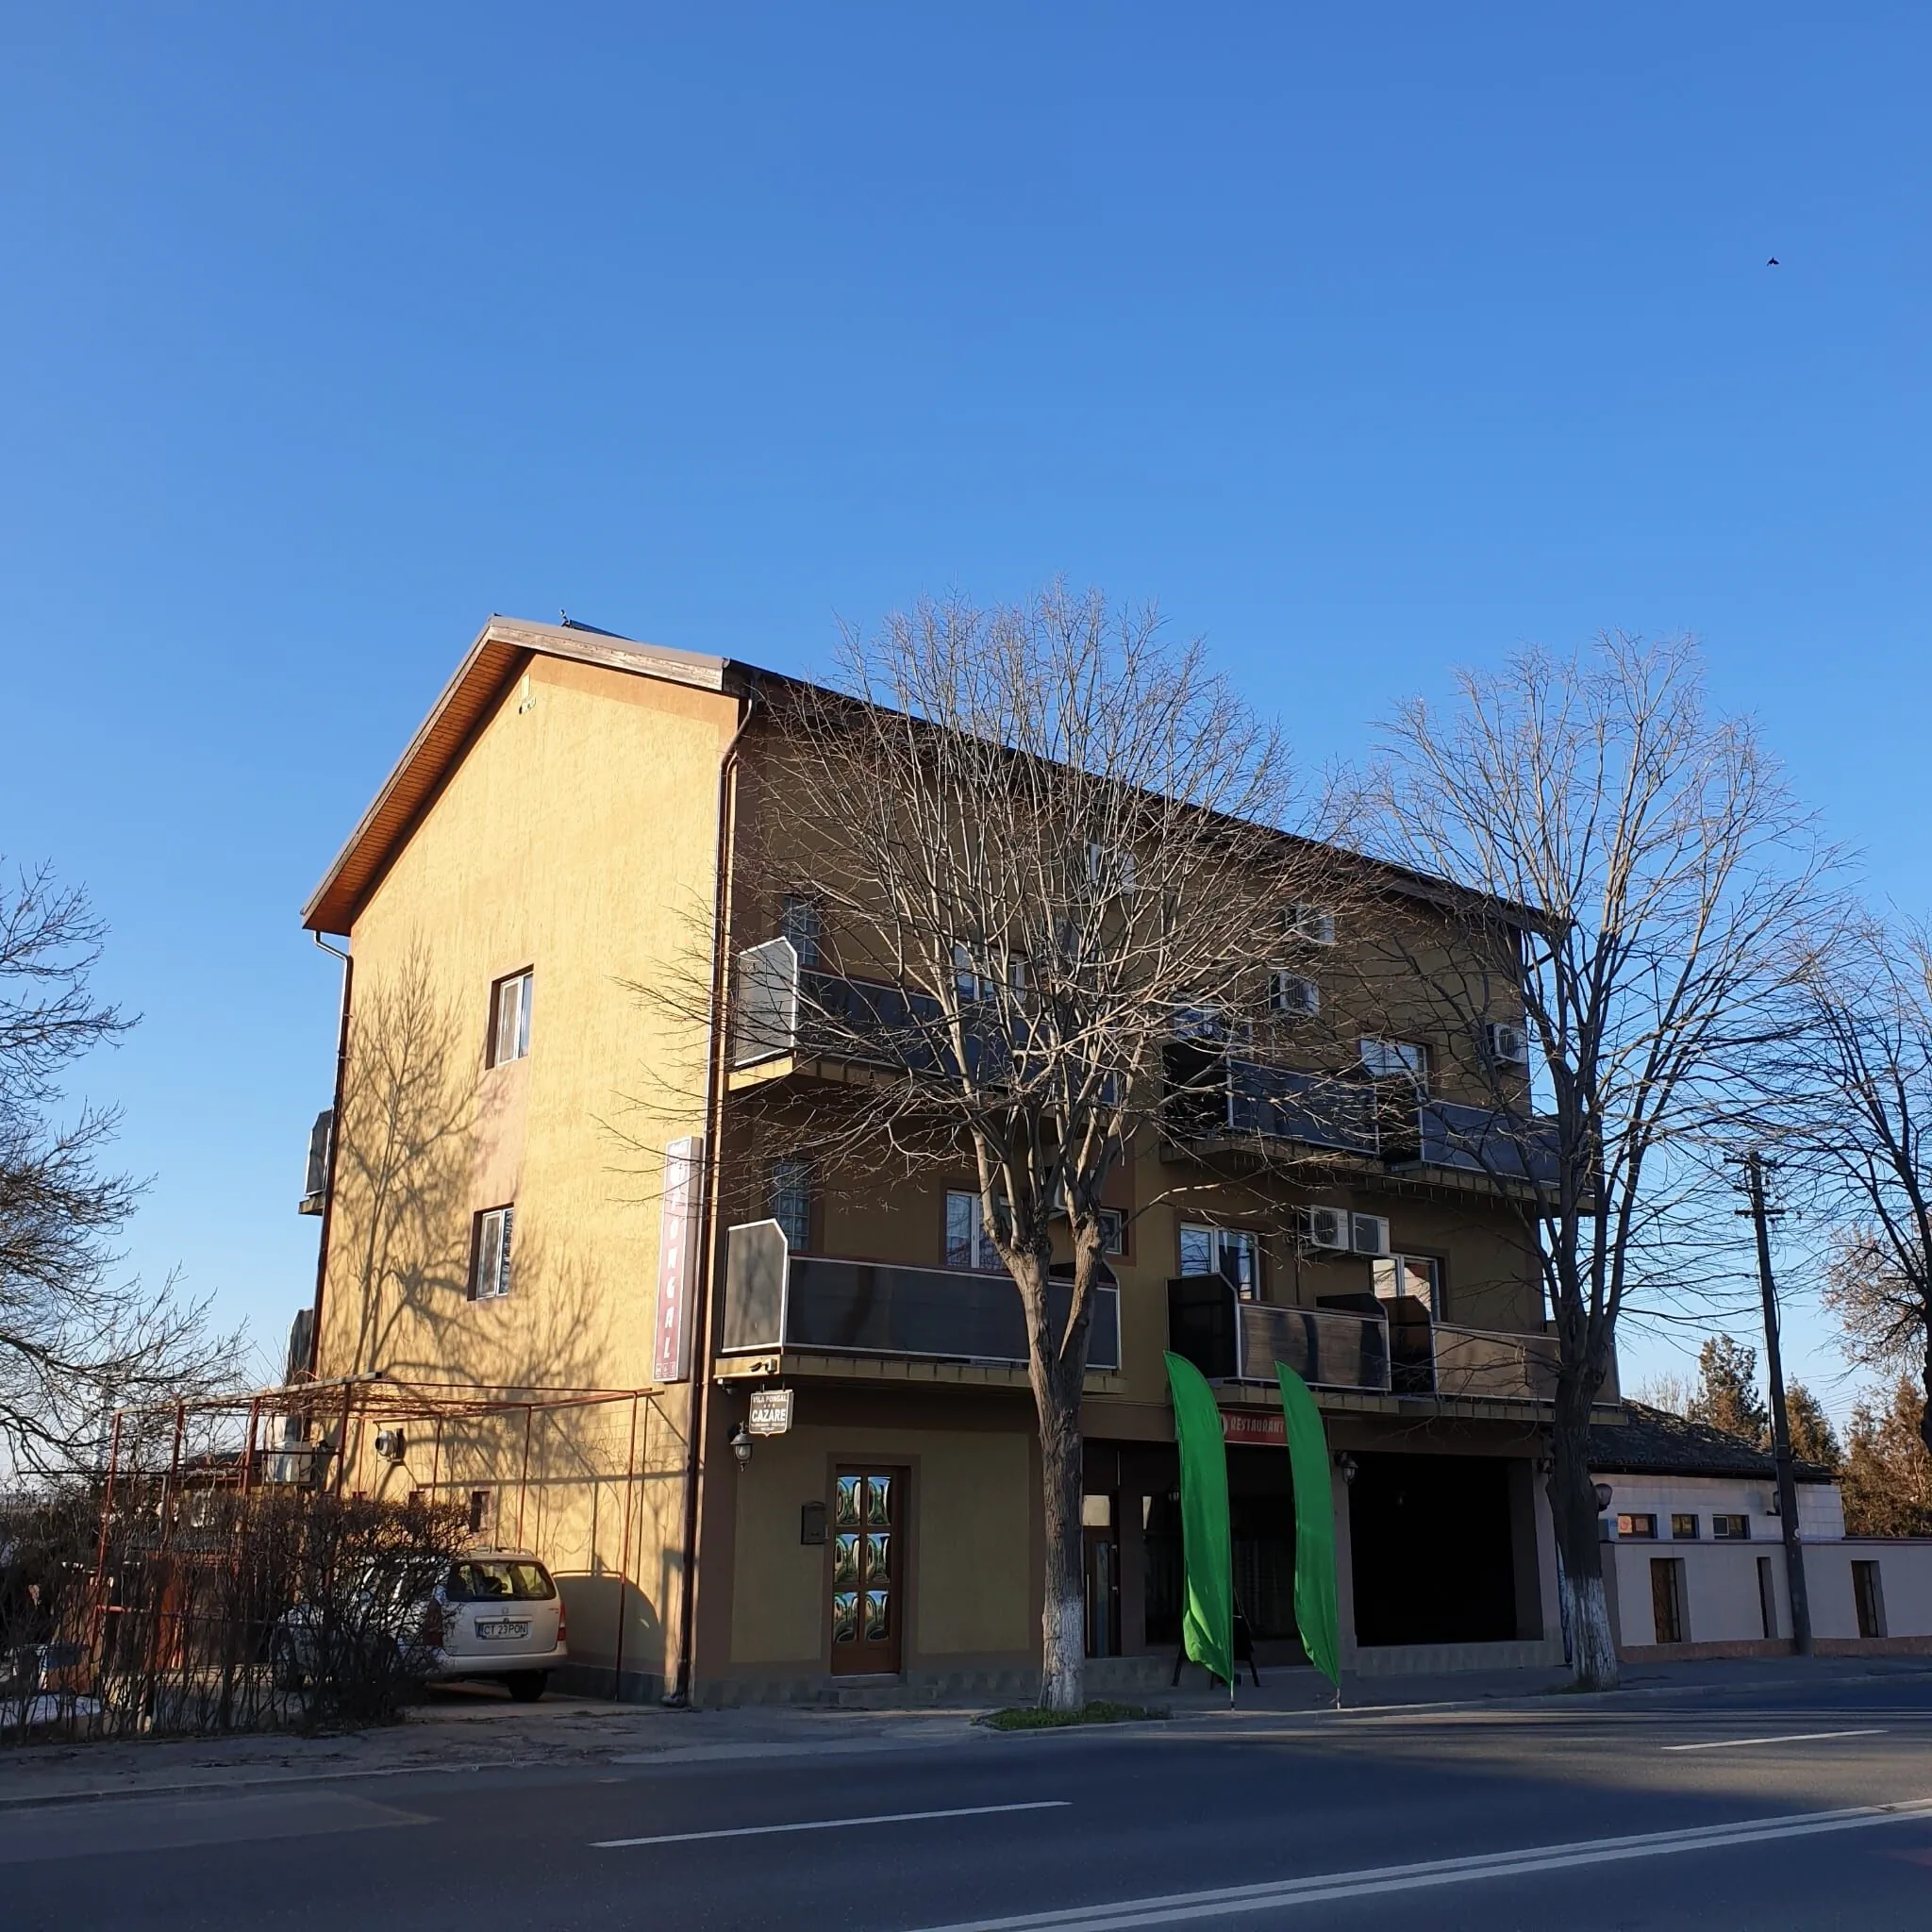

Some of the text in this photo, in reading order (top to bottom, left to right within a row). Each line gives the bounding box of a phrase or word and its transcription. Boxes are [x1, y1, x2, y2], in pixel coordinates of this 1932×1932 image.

[753, 1395, 765, 1404] VILA
[752, 1408, 786, 1422] CAZARE
[1231, 1417, 1283, 1433] RESTAURANT
[484, 1624, 495, 1635] CT
[497, 1624, 508, 1635] 23
